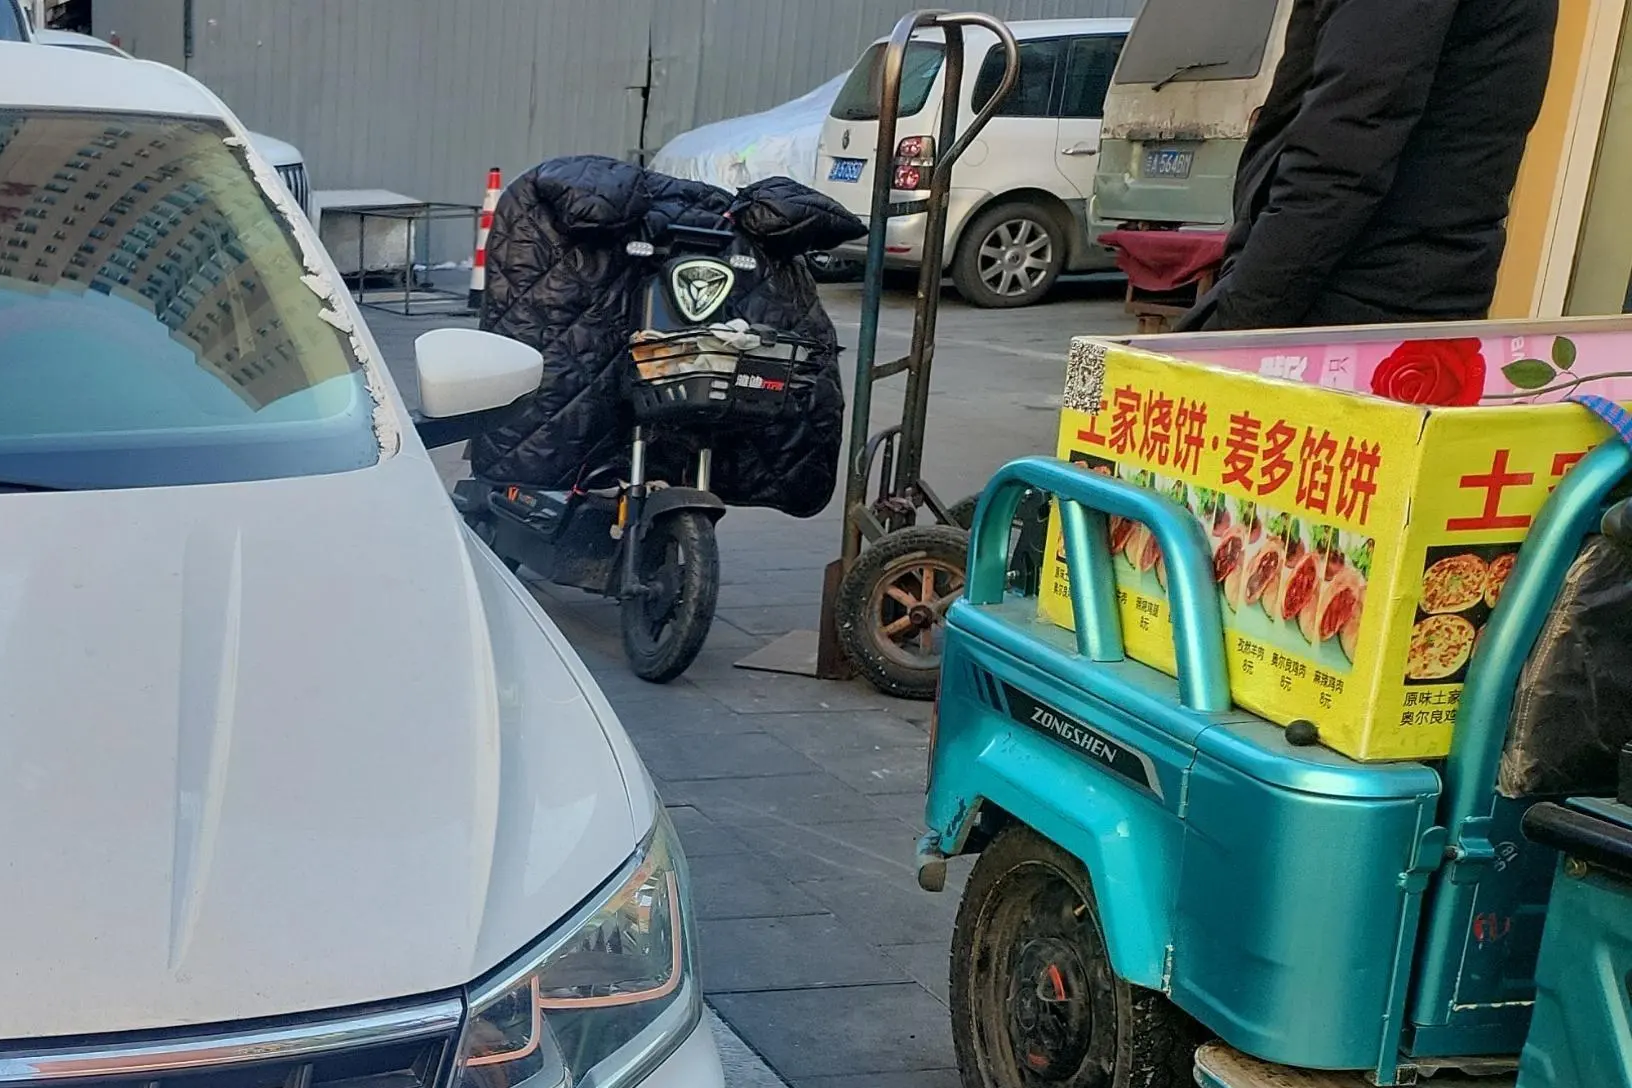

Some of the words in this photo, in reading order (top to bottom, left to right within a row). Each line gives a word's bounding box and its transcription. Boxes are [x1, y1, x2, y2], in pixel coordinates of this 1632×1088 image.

[1271, 652, 1306, 679] 奥尔良鸡肉
[1030, 706, 1117, 763] ZONGSHEN
